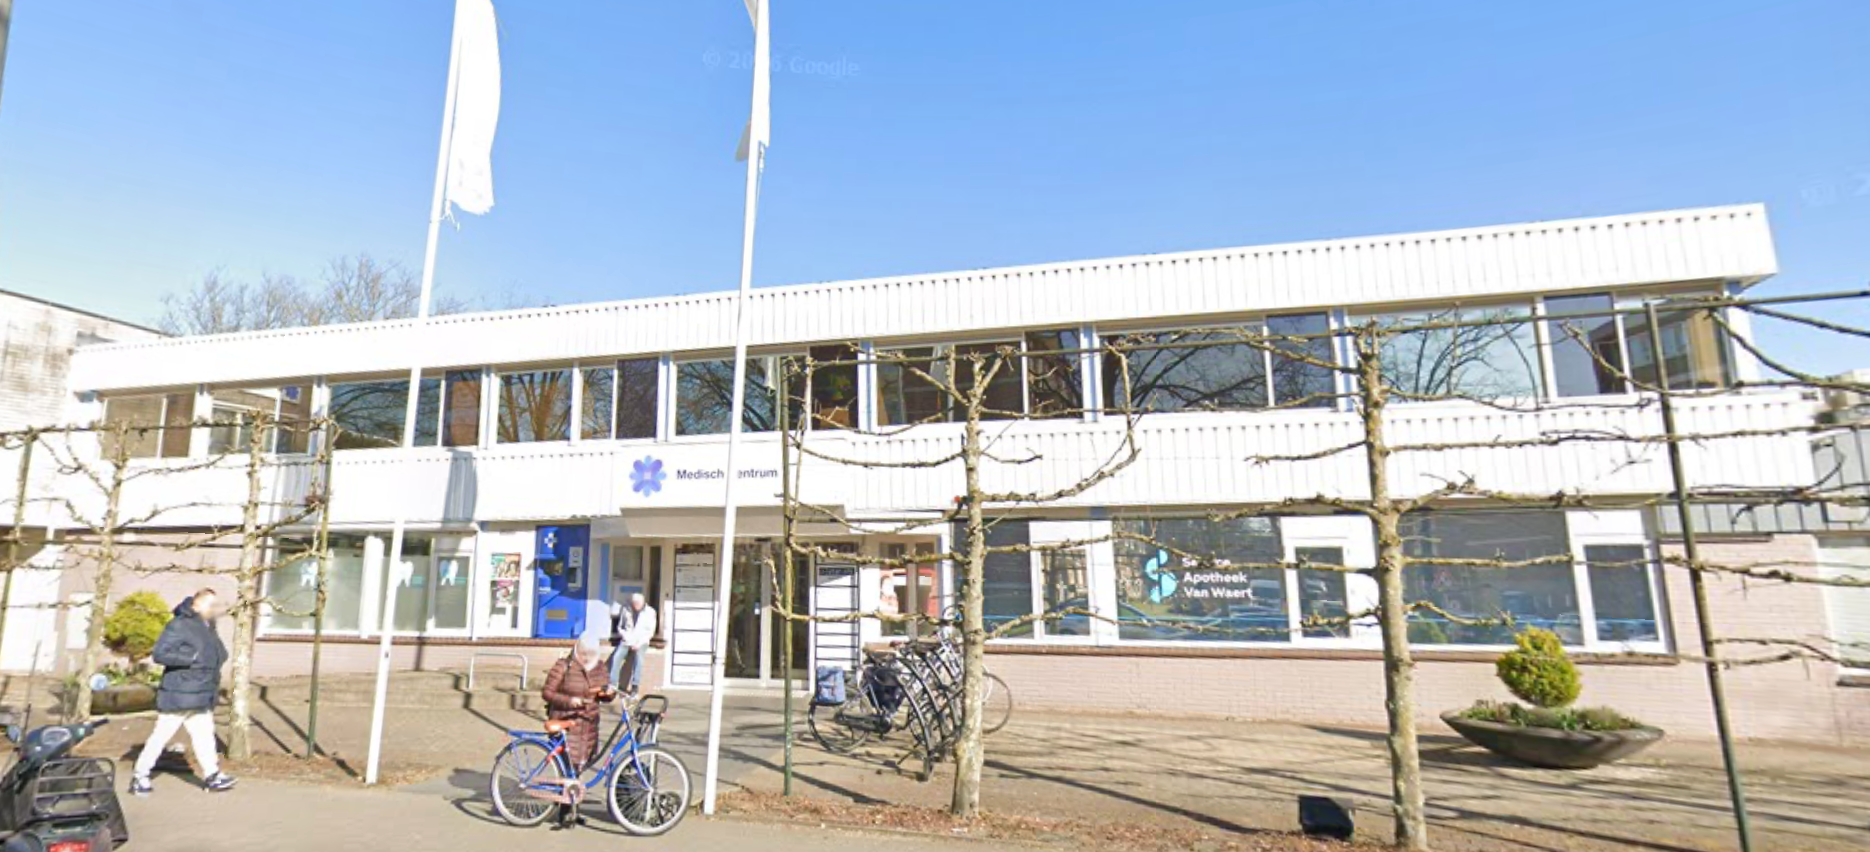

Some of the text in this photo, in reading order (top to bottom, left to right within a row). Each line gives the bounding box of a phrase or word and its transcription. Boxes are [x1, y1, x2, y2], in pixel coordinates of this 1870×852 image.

[676, 468, 778, 480] Medisch entrum
[1182, 557, 1232, 568] Sece
[1184, 571, 1249, 586] Apotheek
[1184, 586, 1254, 599] Van Waert
